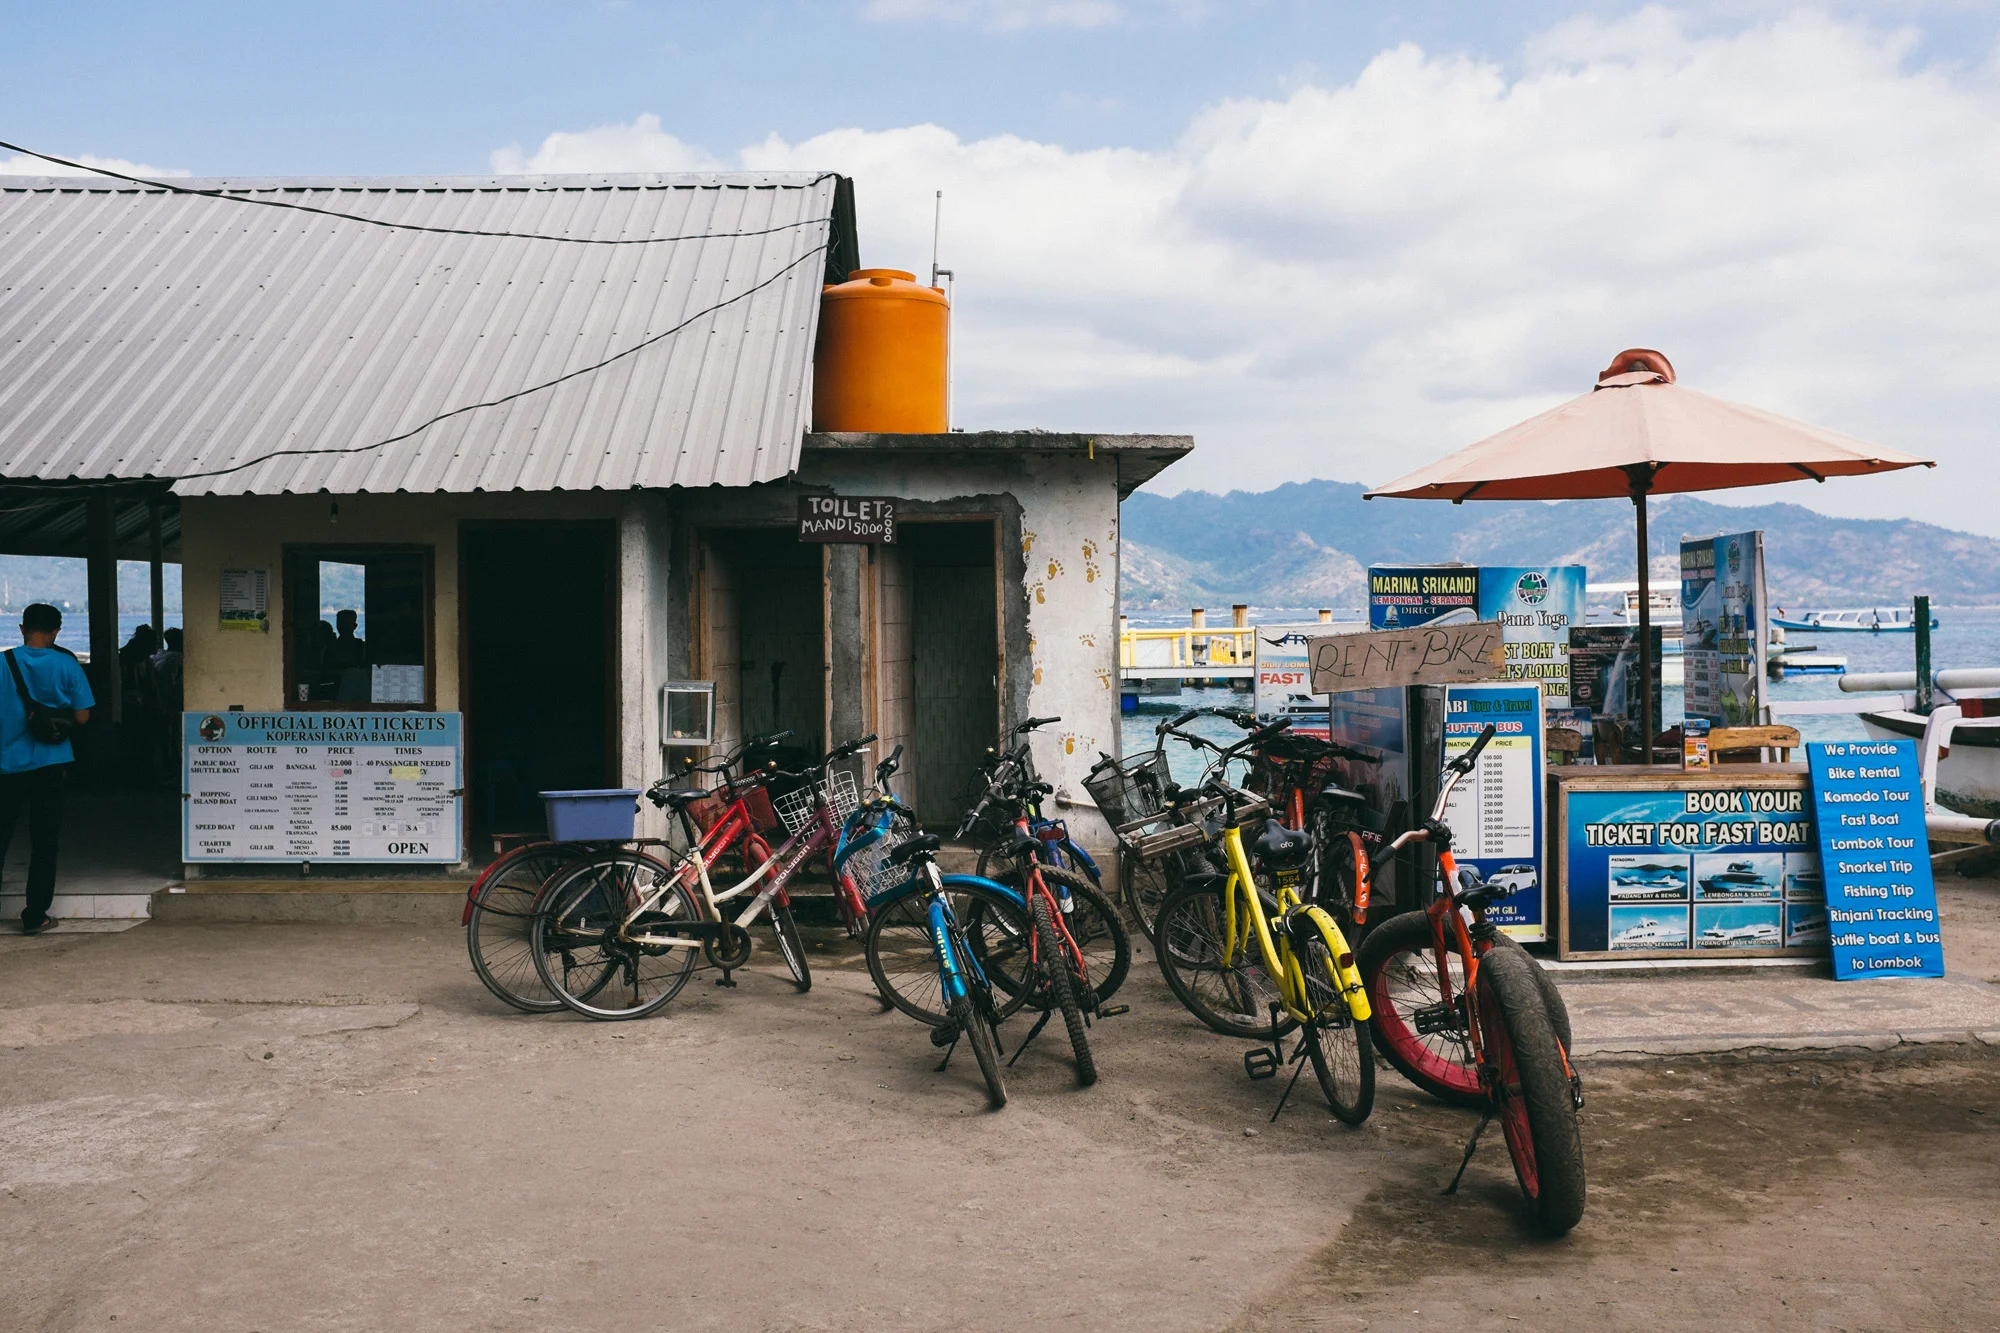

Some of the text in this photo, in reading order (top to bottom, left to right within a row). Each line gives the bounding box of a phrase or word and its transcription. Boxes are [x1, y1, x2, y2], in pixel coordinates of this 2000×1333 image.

[808, 497, 886, 520] TOILET
[801, 518, 852, 534] MANDI
[1372, 576, 1476, 594] MARINA SRIKANDI
[1372, 596, 1473, 605] LEMBONGAN SERANGAN
[1401, 606, 1437, 614] DIRECT
[1497, 610, 1569, 630] Dana Yoga
[1504, 643, 1519, 658] ST
[1522, 643, 1554, 658] BOAT
[1311, 629, 1495, 689] RENT BIKE
[1260, 673, 1304, 684] FAST
[1470, 700, 1491, 712] Tour
[1493, 700, 1502, 712] &
[1504, 699, 1532, 711] Travel
[237, 716, 446, 730] OFFICIAL BOAT TICKETS
[1446, 721, 1523, 733] HUTTL BUS
[266, 731, 416, 742] KOPERASI KARYA BAHARI
[198, 746, 232, 754] OFTION
[395, 747, 422, 755] TIMES
[1824, 743, 1898, 756] We Provide
[1828, 766, 1900, 779] Bike Rental
[1686, 790, 1803, 813] BOOK YOUR
[1824, 789, 1910, 803] Komodo Tour
[1841, 813, 1899, 826] Fast Boat
[1586, 822, 1810, 846] TICKET FOR FAST BOAT
[388, 842, 429, 854] OPEN
[1280, 841, 1294, 849] ofo
[1831, 836, 1914, 850] Lombok Tour
[702, 837, 730, 870] OLYGON
[774, 844, 811, 886] POLYGON
[1838, 860, 1913, 874] Snorkel Trip
[1843, 884, 1914, 899] Fishing Trip
[1485, 906, 1517, 915] OM GILI
[1830, 908, 1933, 924] Rinjani Tracking
[1831, 932, 1940, 946] Suttle boat & bus
[1852, 956, 1922, 970] to Lombok
